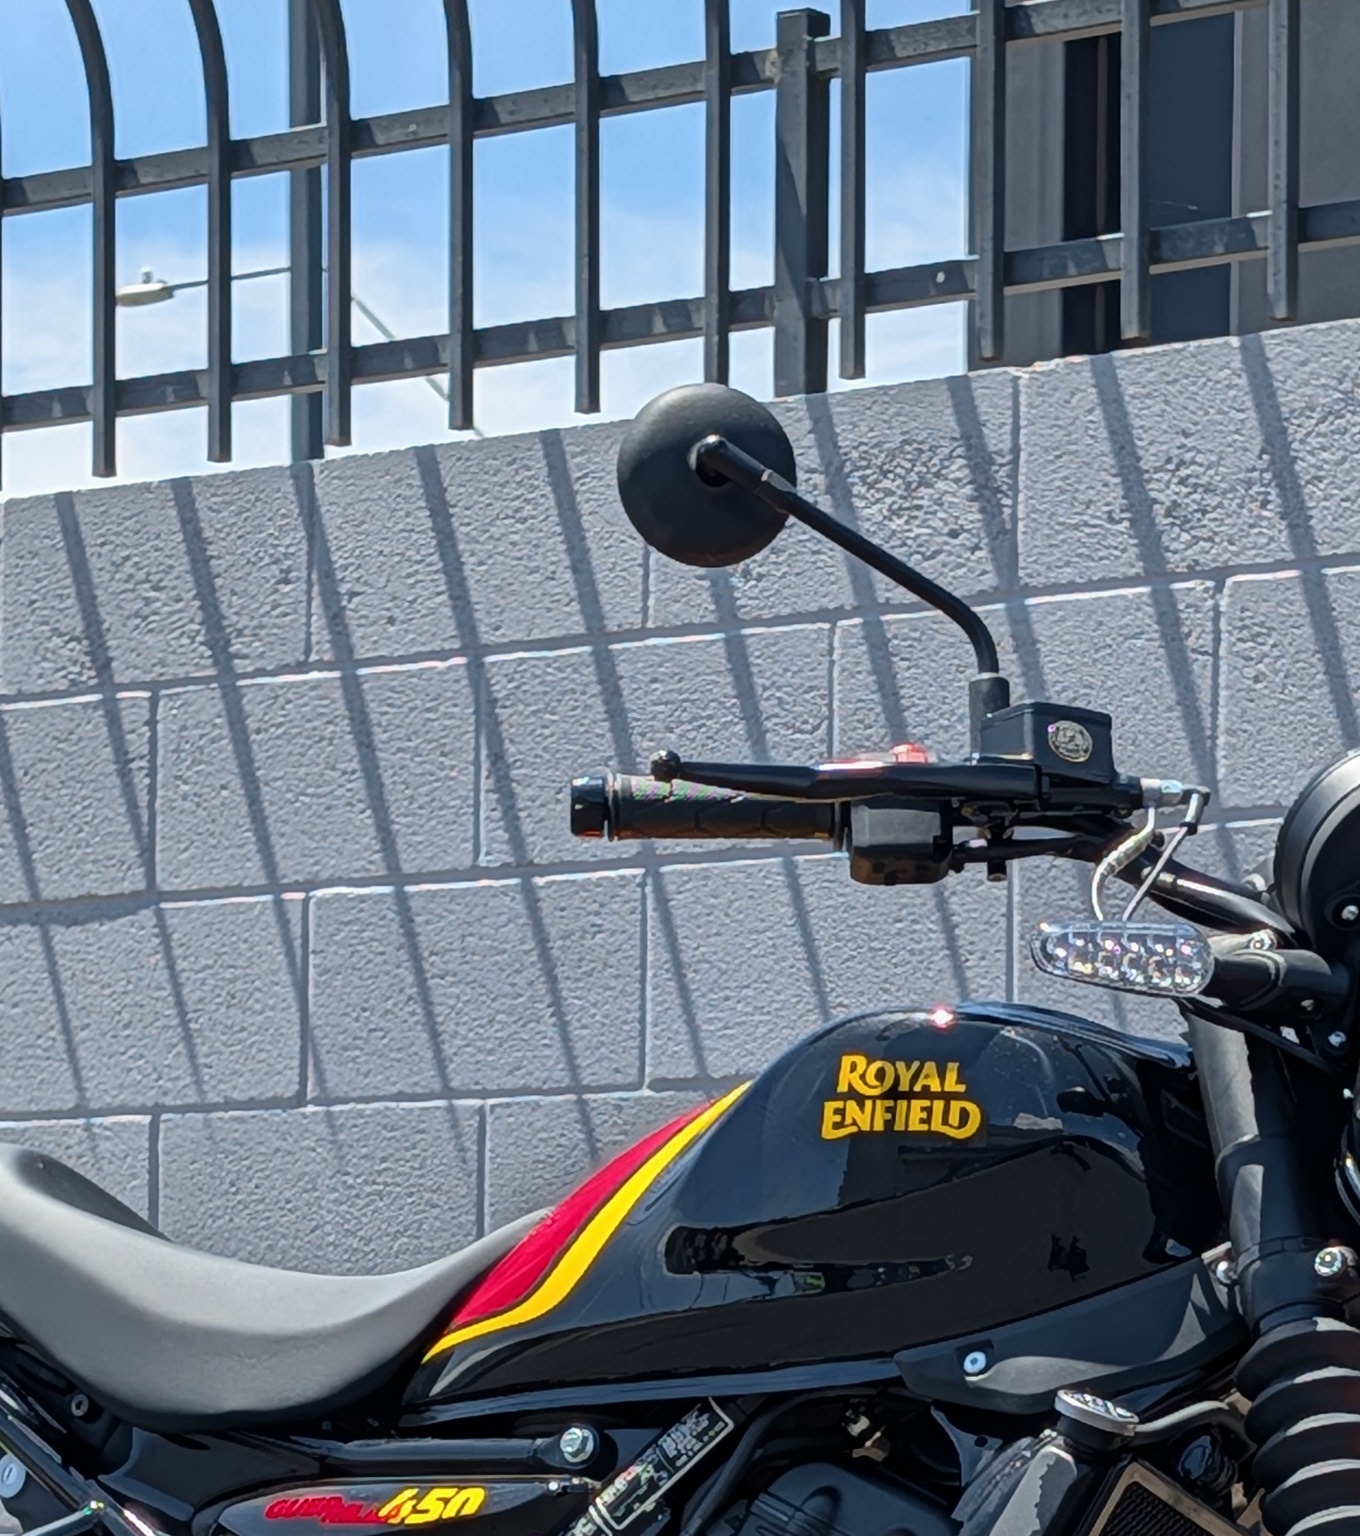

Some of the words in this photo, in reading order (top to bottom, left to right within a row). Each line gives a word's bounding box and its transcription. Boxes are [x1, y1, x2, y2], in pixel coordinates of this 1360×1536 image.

[837, 1054, 967, 1096] ROYAL
[821, 1099, 981, 1139] ENFIELD
[378, 1486, 485, 1525] 450
